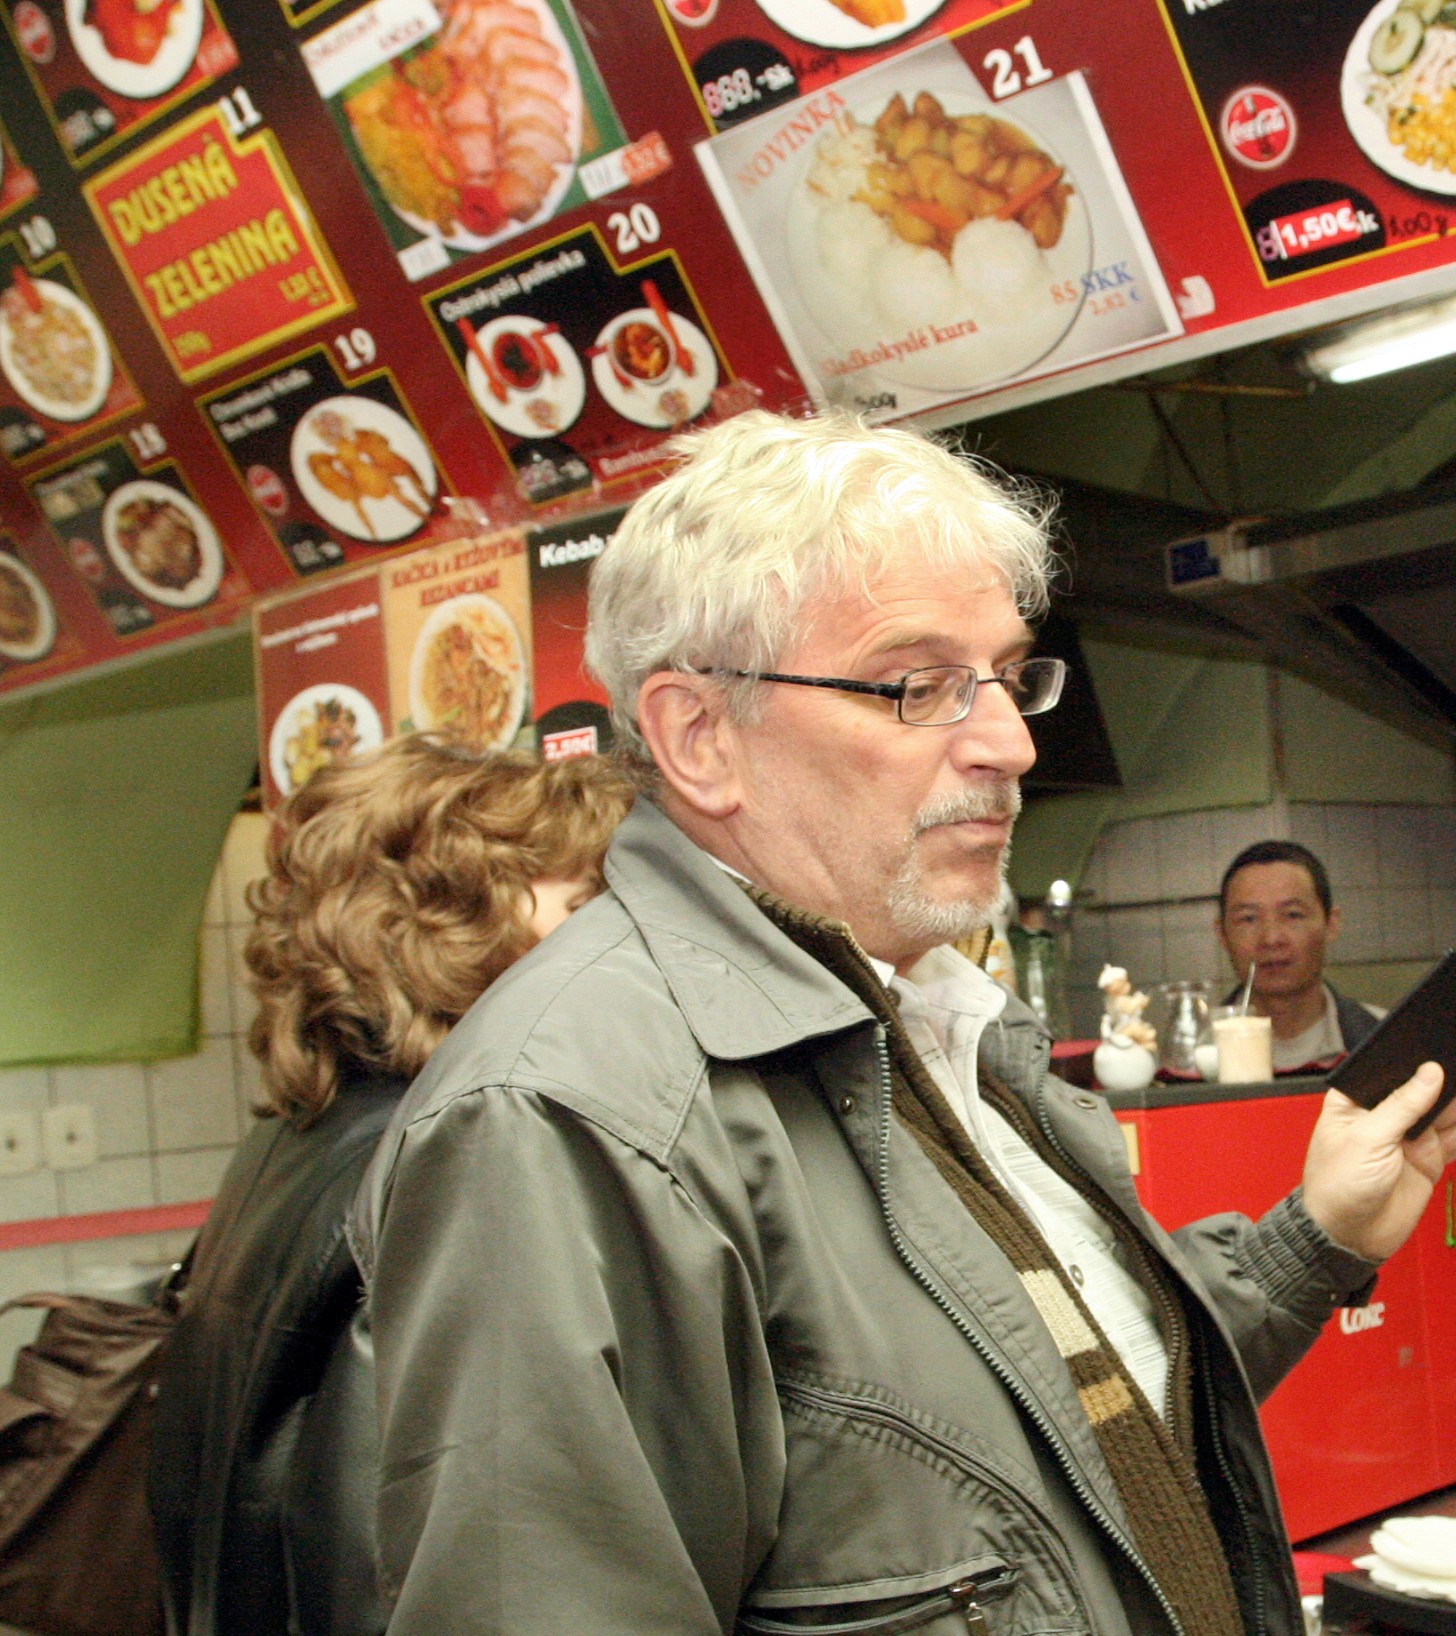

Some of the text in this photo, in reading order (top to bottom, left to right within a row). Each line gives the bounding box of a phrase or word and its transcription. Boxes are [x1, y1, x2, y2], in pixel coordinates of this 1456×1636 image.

[983, 36, 1052, 97] 21
[219, 86, 262, 135] 11
[735, 90, 847, 191] NOVINKA
[607, 202, 662, 254] 20
[144, 208, 299, 318] ZELENINA
[334, 327, 377, 371] 19
[928, 318, 980, 344] kura
[538, 533, 606, 568] Kebab
